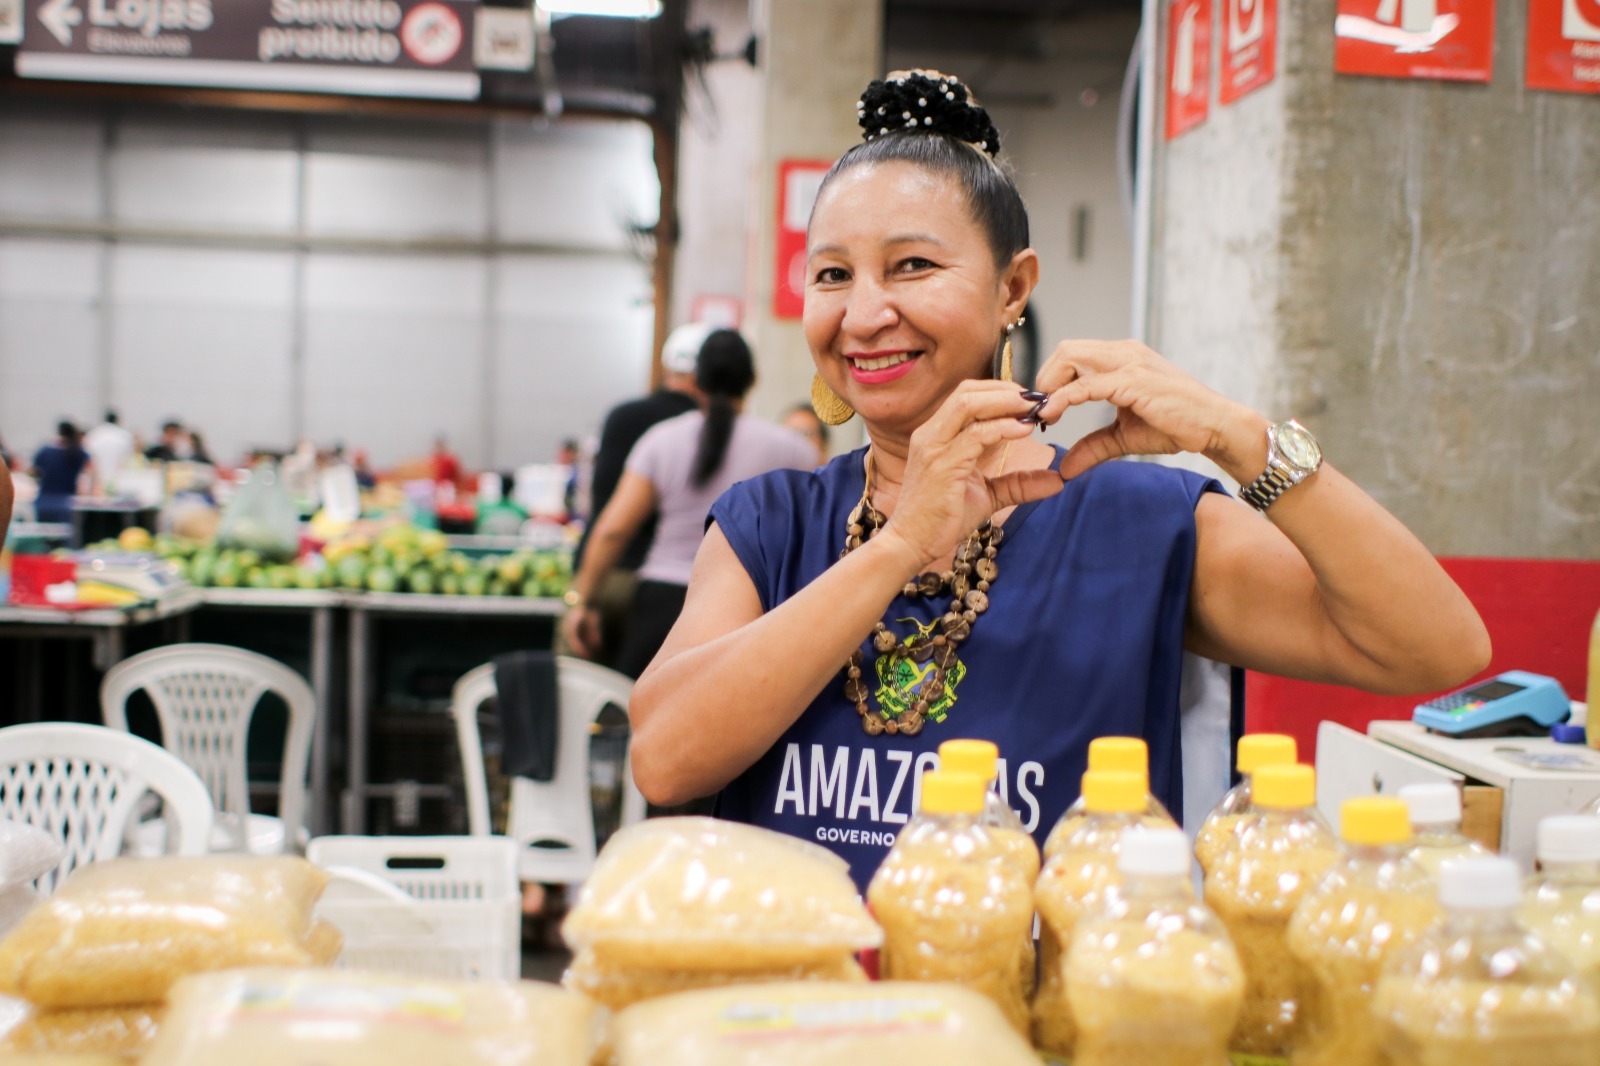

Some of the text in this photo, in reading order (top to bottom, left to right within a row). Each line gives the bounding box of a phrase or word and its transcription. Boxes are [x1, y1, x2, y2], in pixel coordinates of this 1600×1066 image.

[89, 0, 213, 36] Lojas
[271, 0, 401, 28] Sentido
[259, 24, 400, 62] proibido
[816, 826, 896, 847] GOVERNO
